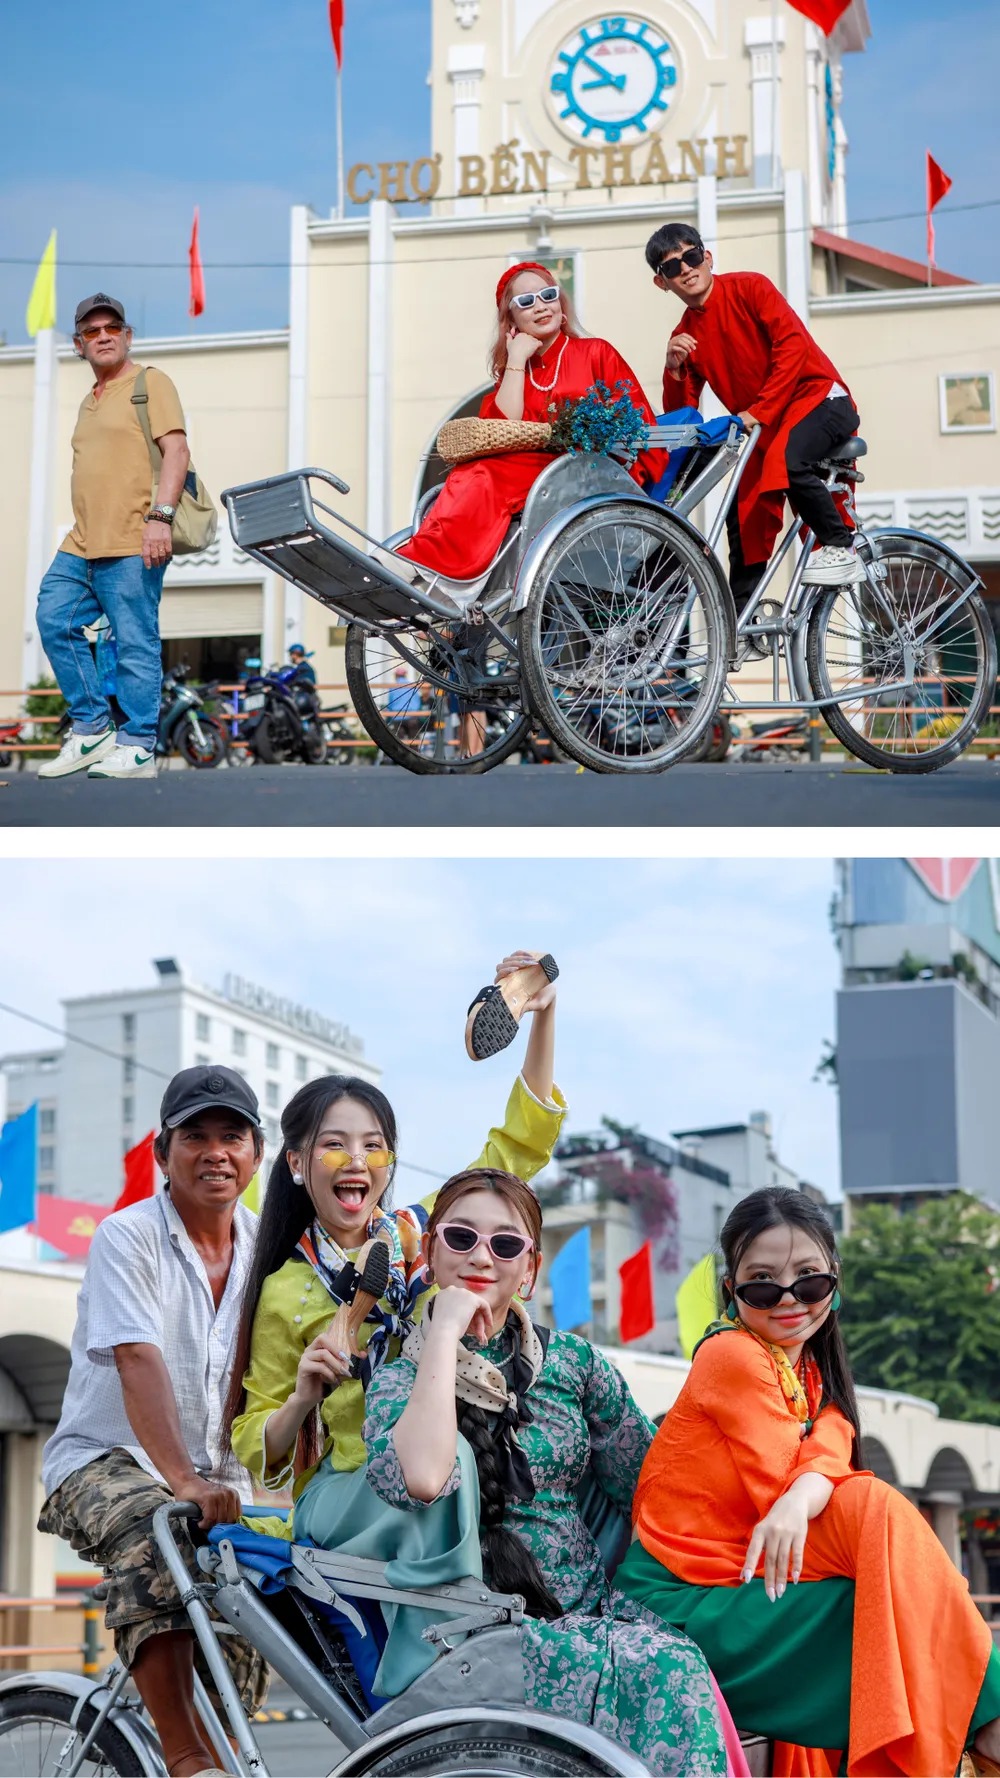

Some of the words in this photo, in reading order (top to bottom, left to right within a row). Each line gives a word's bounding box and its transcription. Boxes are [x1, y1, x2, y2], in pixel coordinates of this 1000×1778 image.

[599, 16, 627, 33] 12
[346, 153, 443, 205] CHỢ
[458, 138, 551, 196] BẾN
[568, 131, 749, 188] THÀNH
